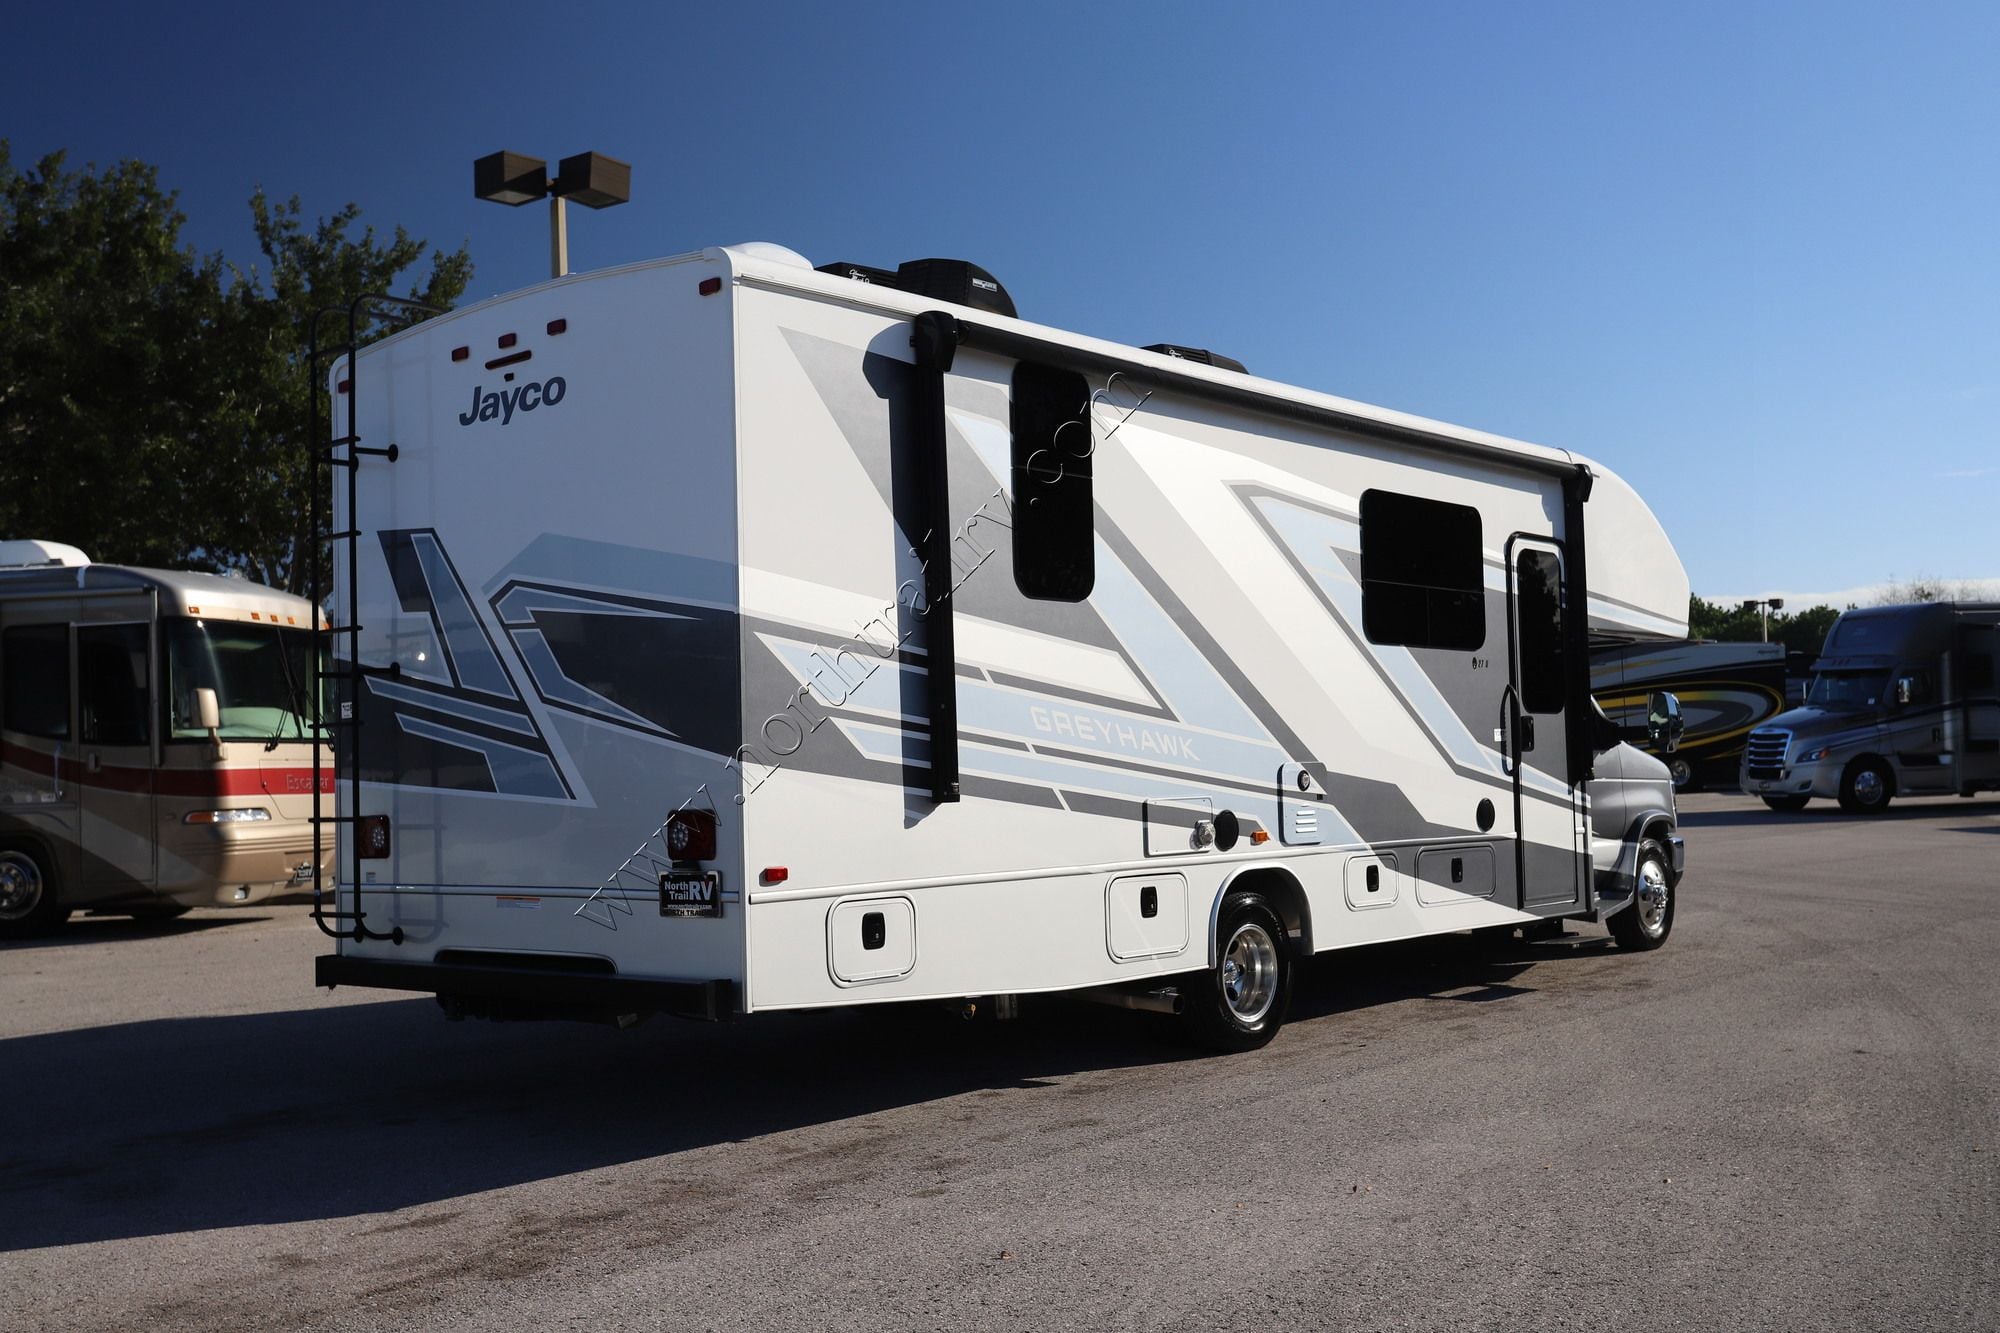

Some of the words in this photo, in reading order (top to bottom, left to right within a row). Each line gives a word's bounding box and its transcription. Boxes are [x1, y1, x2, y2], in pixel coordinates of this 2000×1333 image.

[459, 376, 567, 426] Jayco
[1029, 705, 1200, 761] GREYHAWK
[286, 774, 329, 790] Escaer
[664, 881, 688, 891] North
[689, 881, 713, 900] RV
[669, 891, 688, 900] Trail
